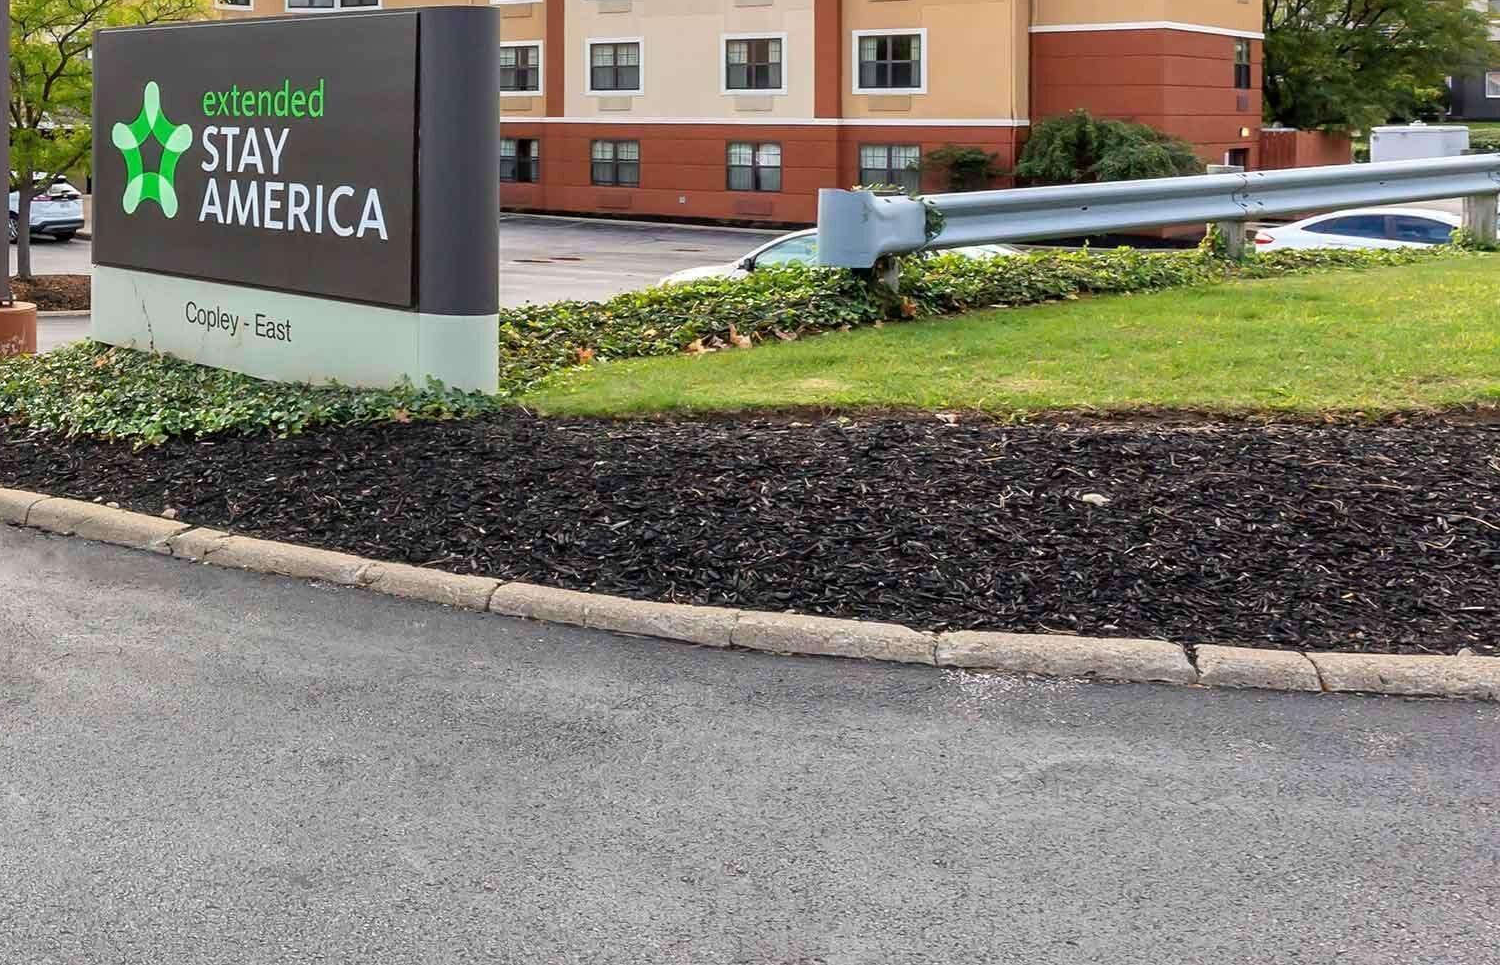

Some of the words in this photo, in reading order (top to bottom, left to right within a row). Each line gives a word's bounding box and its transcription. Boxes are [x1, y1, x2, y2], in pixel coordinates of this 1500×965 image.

[202, 78, 325, 117] extended
[201, 125, 290, 174] STAY
[198, 178, 388, 240] AMERICA
[185, 301, 239, 336] Copley
[255, 313, 292, 342] East
